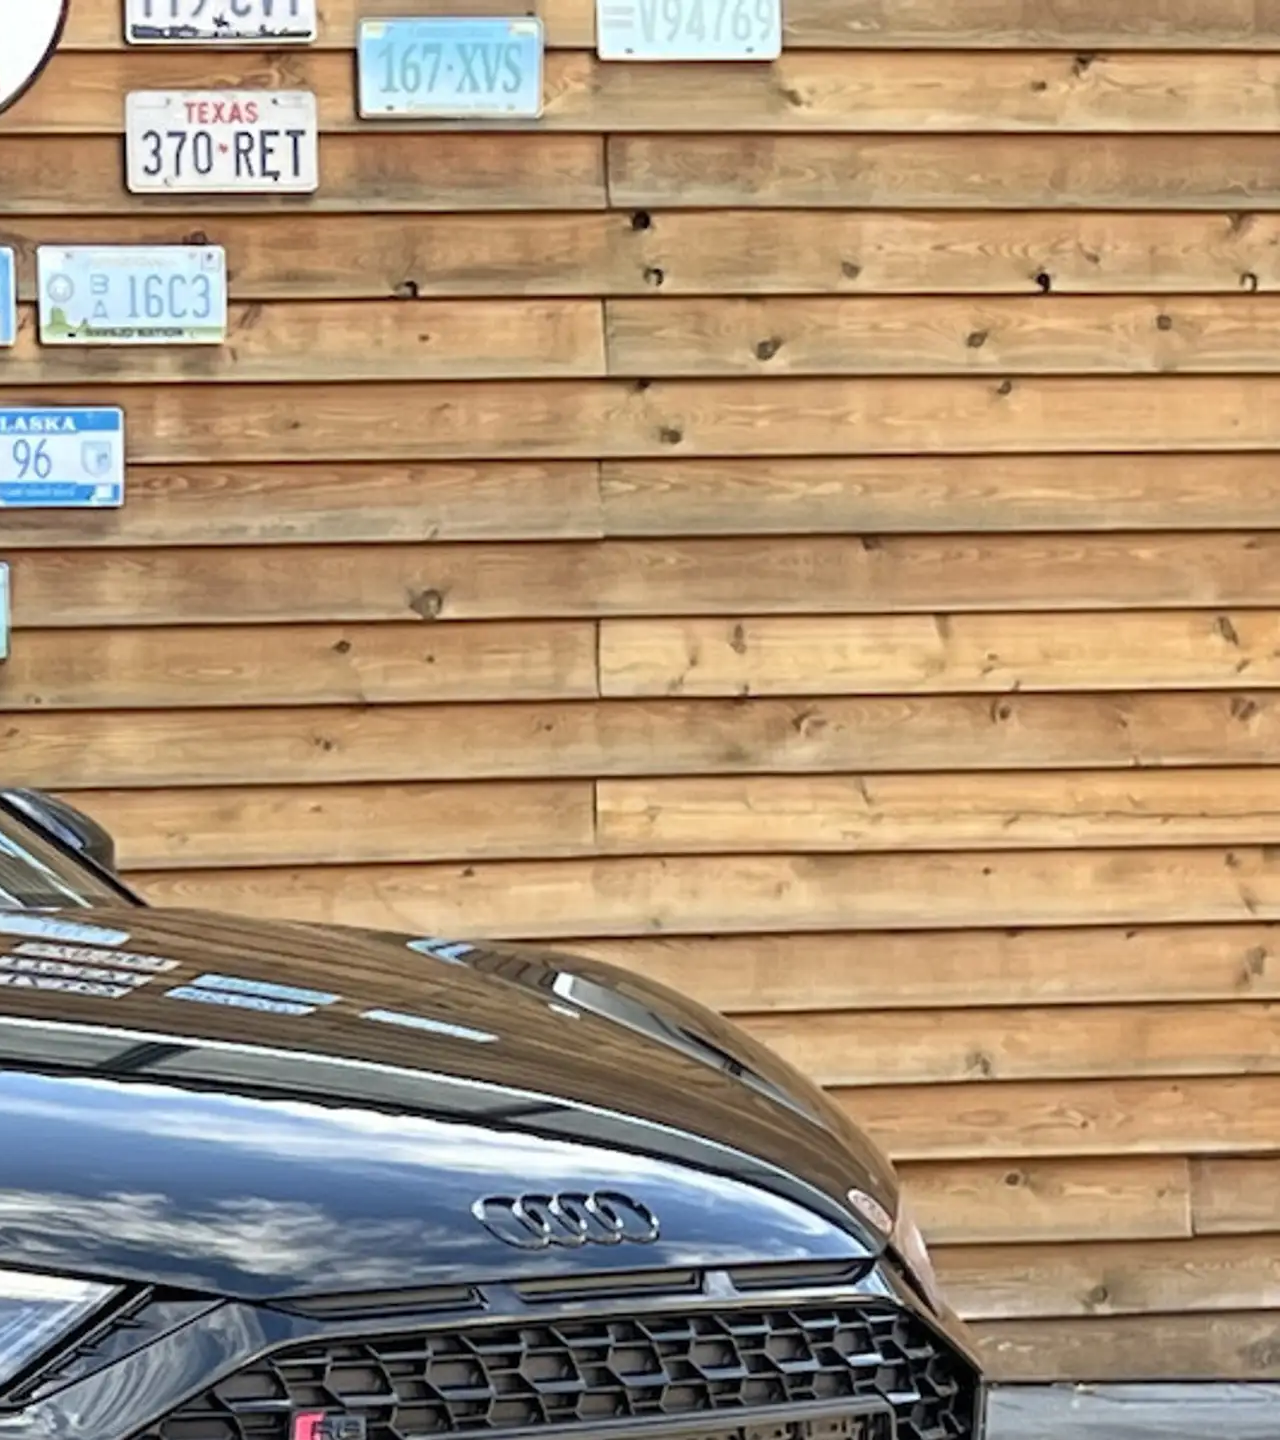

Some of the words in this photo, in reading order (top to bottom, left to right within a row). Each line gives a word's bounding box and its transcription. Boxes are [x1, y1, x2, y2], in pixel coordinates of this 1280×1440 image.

[183, 102, 259, 123] TEXAS
[142, 129, 214, 177] 370
[234, 129, 306, 177] RET
[127, 273, 211, 319] 16C3
[12, 438, 52, 479] 96
